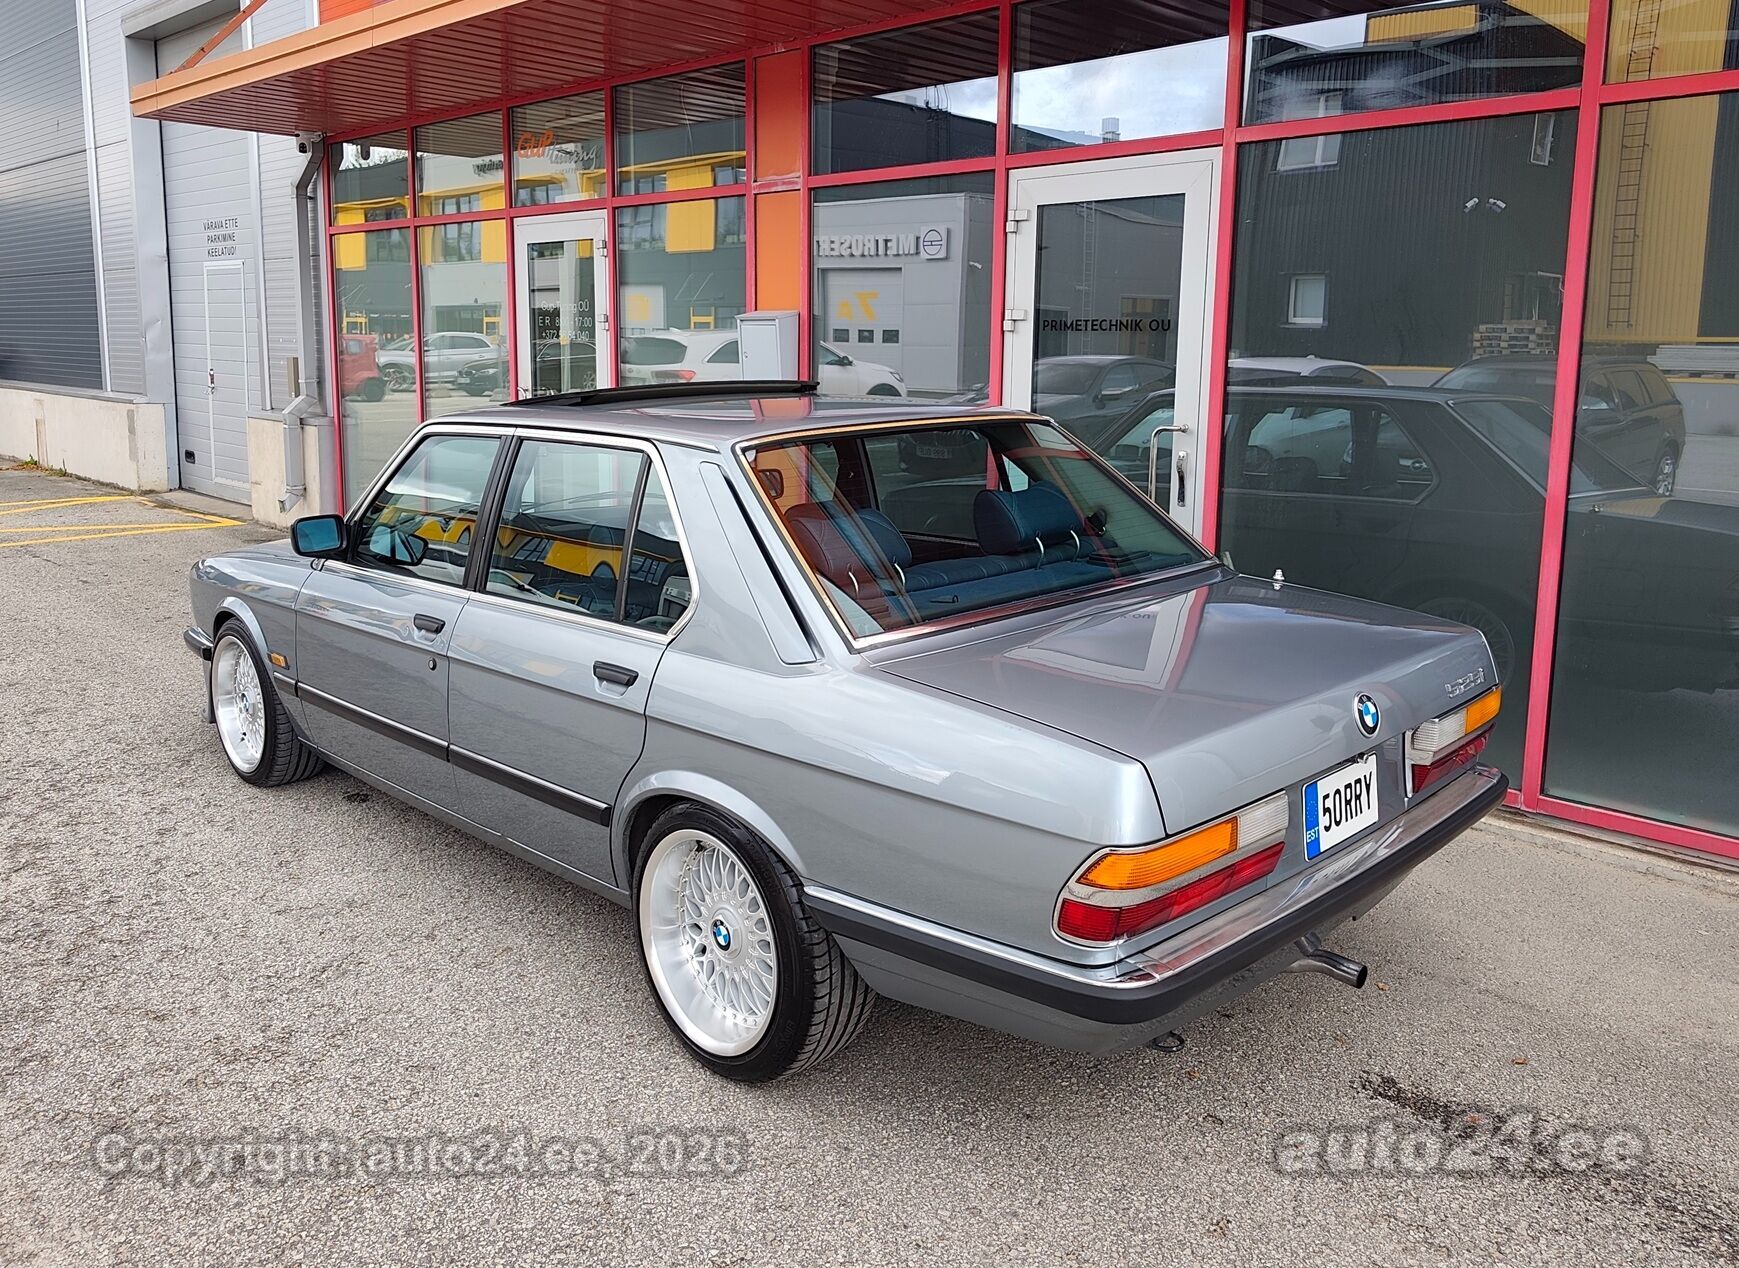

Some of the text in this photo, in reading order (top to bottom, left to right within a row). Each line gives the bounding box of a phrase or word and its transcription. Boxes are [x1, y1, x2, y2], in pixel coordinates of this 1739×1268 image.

[224, 217, 239, 229] ETTE
[207, 232, 236, 244] PARKIMINE
[1042, 319, 1171, 332] PRIMETECHNIK OU
[542, 330, 557, 340] +372
[1306, 826, 1319, 843] EST
